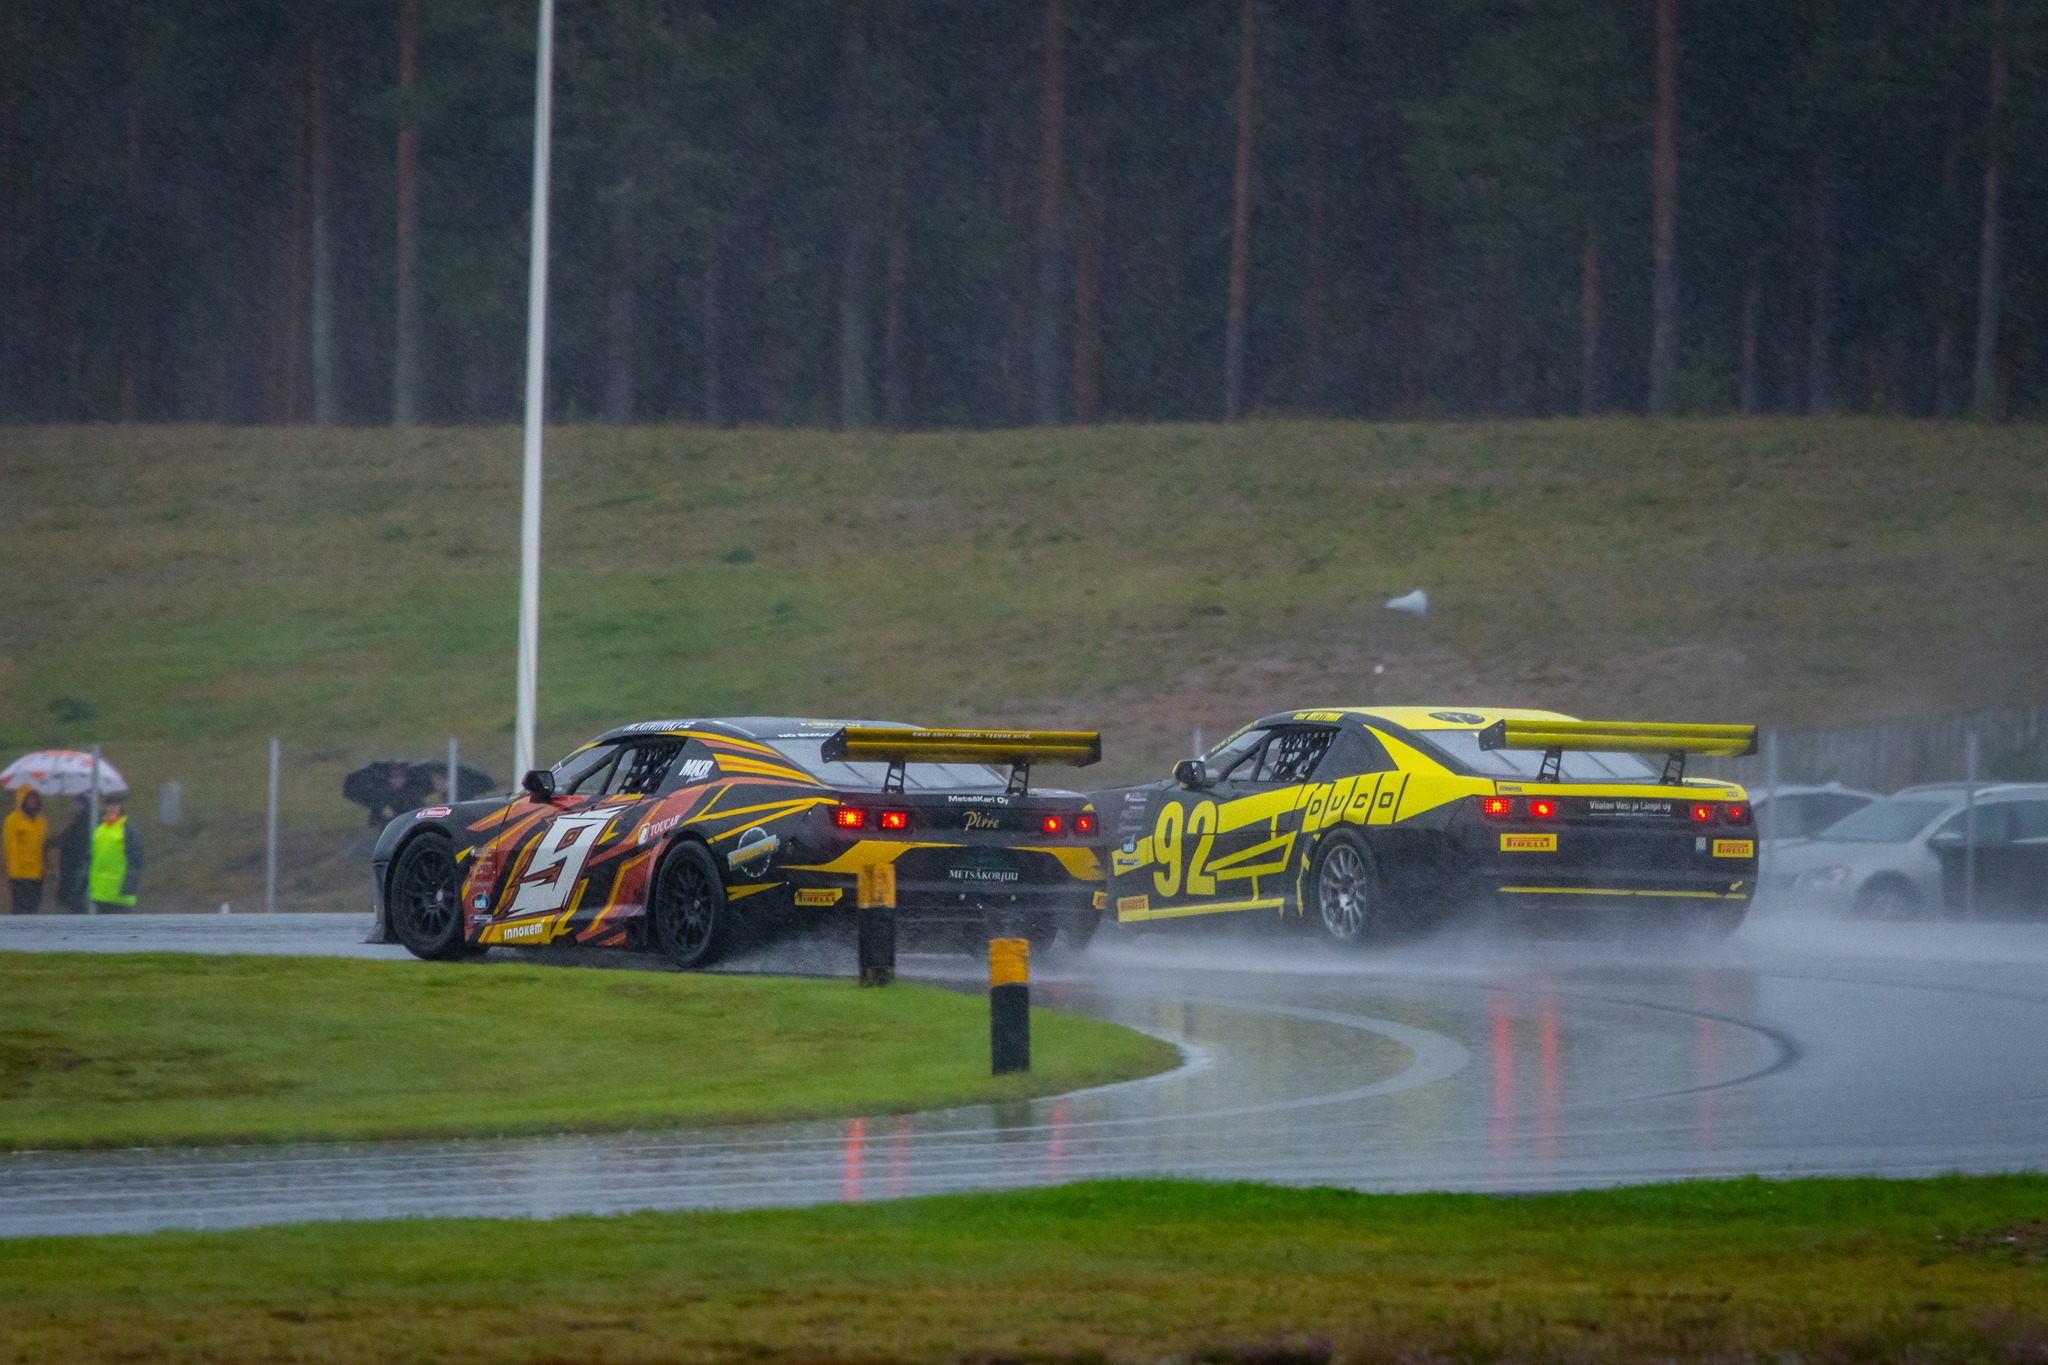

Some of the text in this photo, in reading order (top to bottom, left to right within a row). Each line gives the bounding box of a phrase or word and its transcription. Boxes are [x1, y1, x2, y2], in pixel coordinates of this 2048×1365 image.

[678, 759, 714, 777] MKR
[948, 795, 1009, 805] MetsäKari Oy
[1310, 791, 1395, 816] DUCO
[650, 815, 680, 836] TOUCAR
[962, 810, 1000, 832] Pirre
[1153, 800, 1217, 897] 92
[1506, 837, 1550, 848] PIRELLI
[1717, 843, 1749, 854] PIRELLI
[506, 804, 630, 918] 9
[948, 868, 1019, 883] METSÄKORJUU
